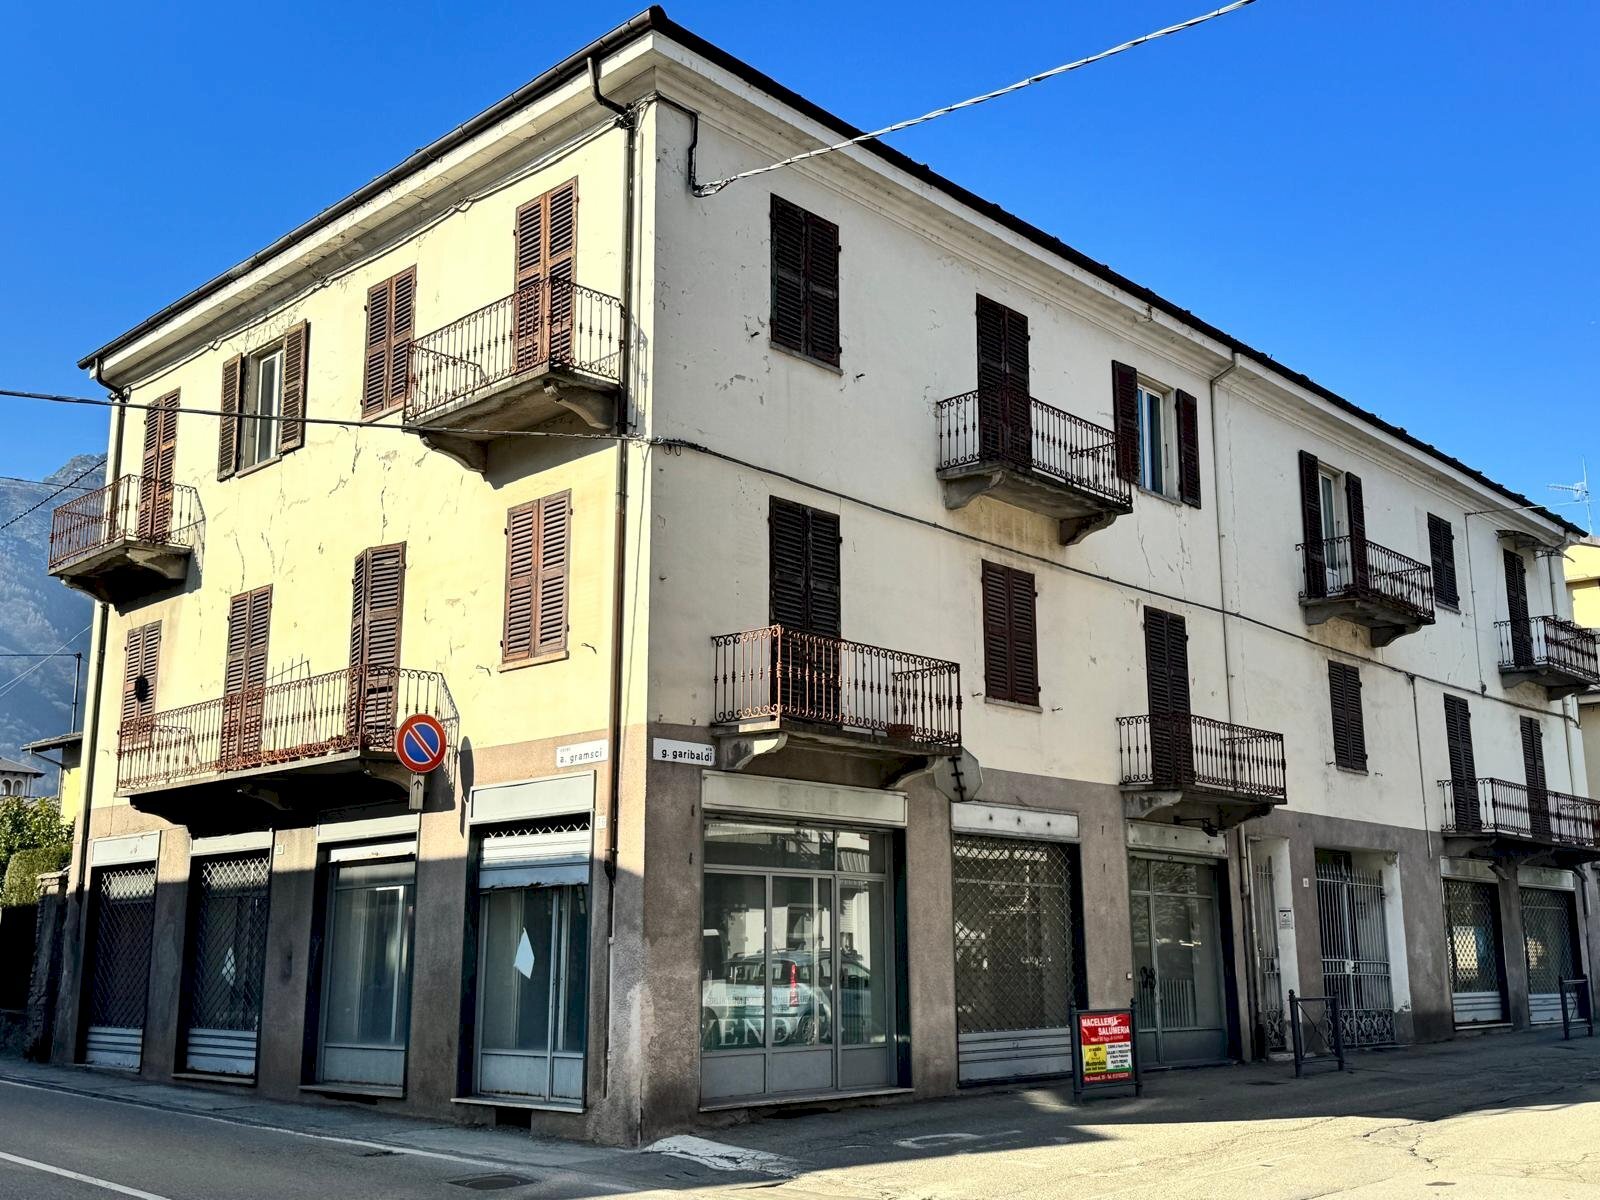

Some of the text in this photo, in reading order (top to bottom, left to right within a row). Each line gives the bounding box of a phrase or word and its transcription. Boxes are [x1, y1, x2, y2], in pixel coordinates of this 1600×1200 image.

[569, 747, 602, 764] gramsci
[661, 749, 712, 762] g. garibaldi
[1081, 1016, 1118, 1027] MACELLERIA
[1097, 1026, 1130, 1036] SALUMERIA
